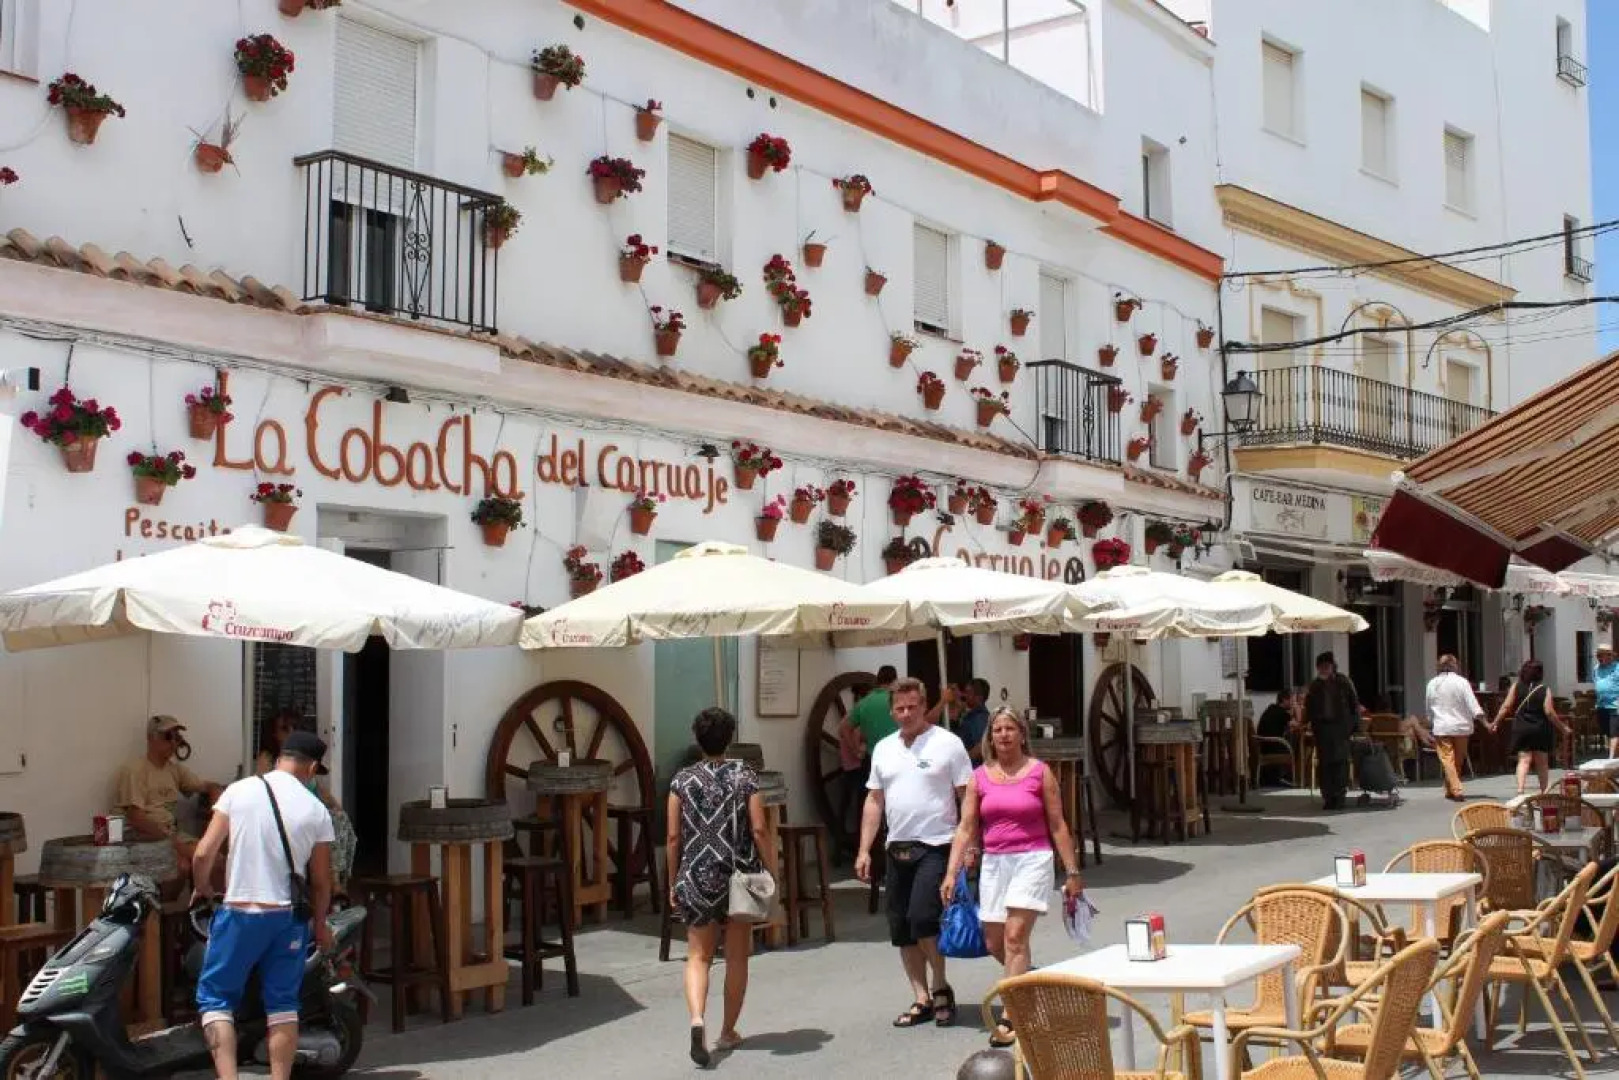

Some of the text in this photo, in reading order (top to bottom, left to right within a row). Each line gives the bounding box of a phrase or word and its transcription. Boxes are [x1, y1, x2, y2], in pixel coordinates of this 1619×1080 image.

[213, 370, 295, 476] La
[537, 434, 590, 487] del
[597, 445, 728, 514] Carruaje
[1294, 492, 1326, 511] MEDINA
[225, 622, 294, 641] Cruzcampo
